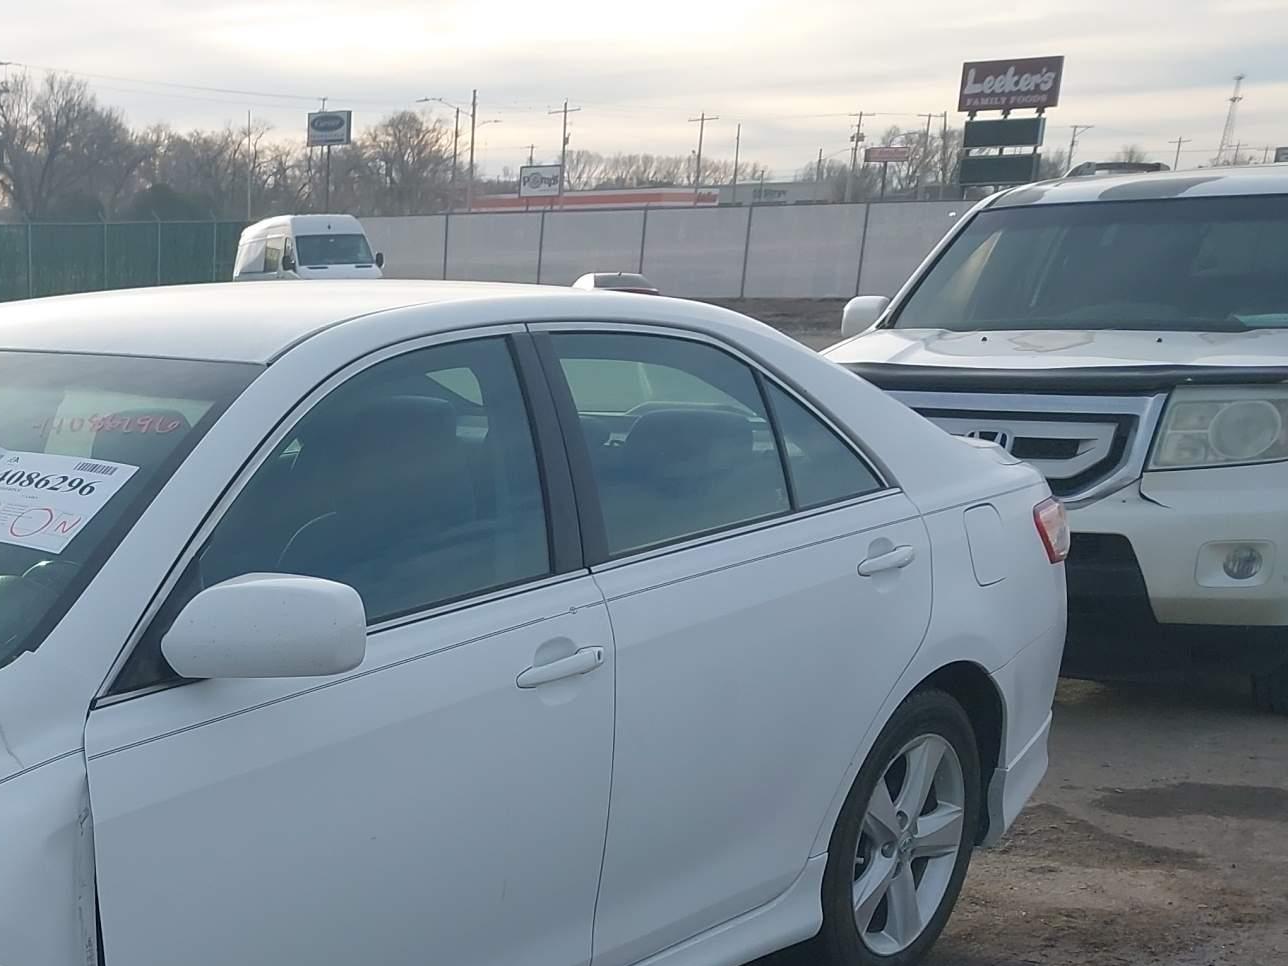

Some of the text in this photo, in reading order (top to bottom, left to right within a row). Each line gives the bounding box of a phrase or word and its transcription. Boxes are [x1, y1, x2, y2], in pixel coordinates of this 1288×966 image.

[964, 67, 1056, 94] Leeker's
[966, 95, 1048, 106] FAMILY FOODS
